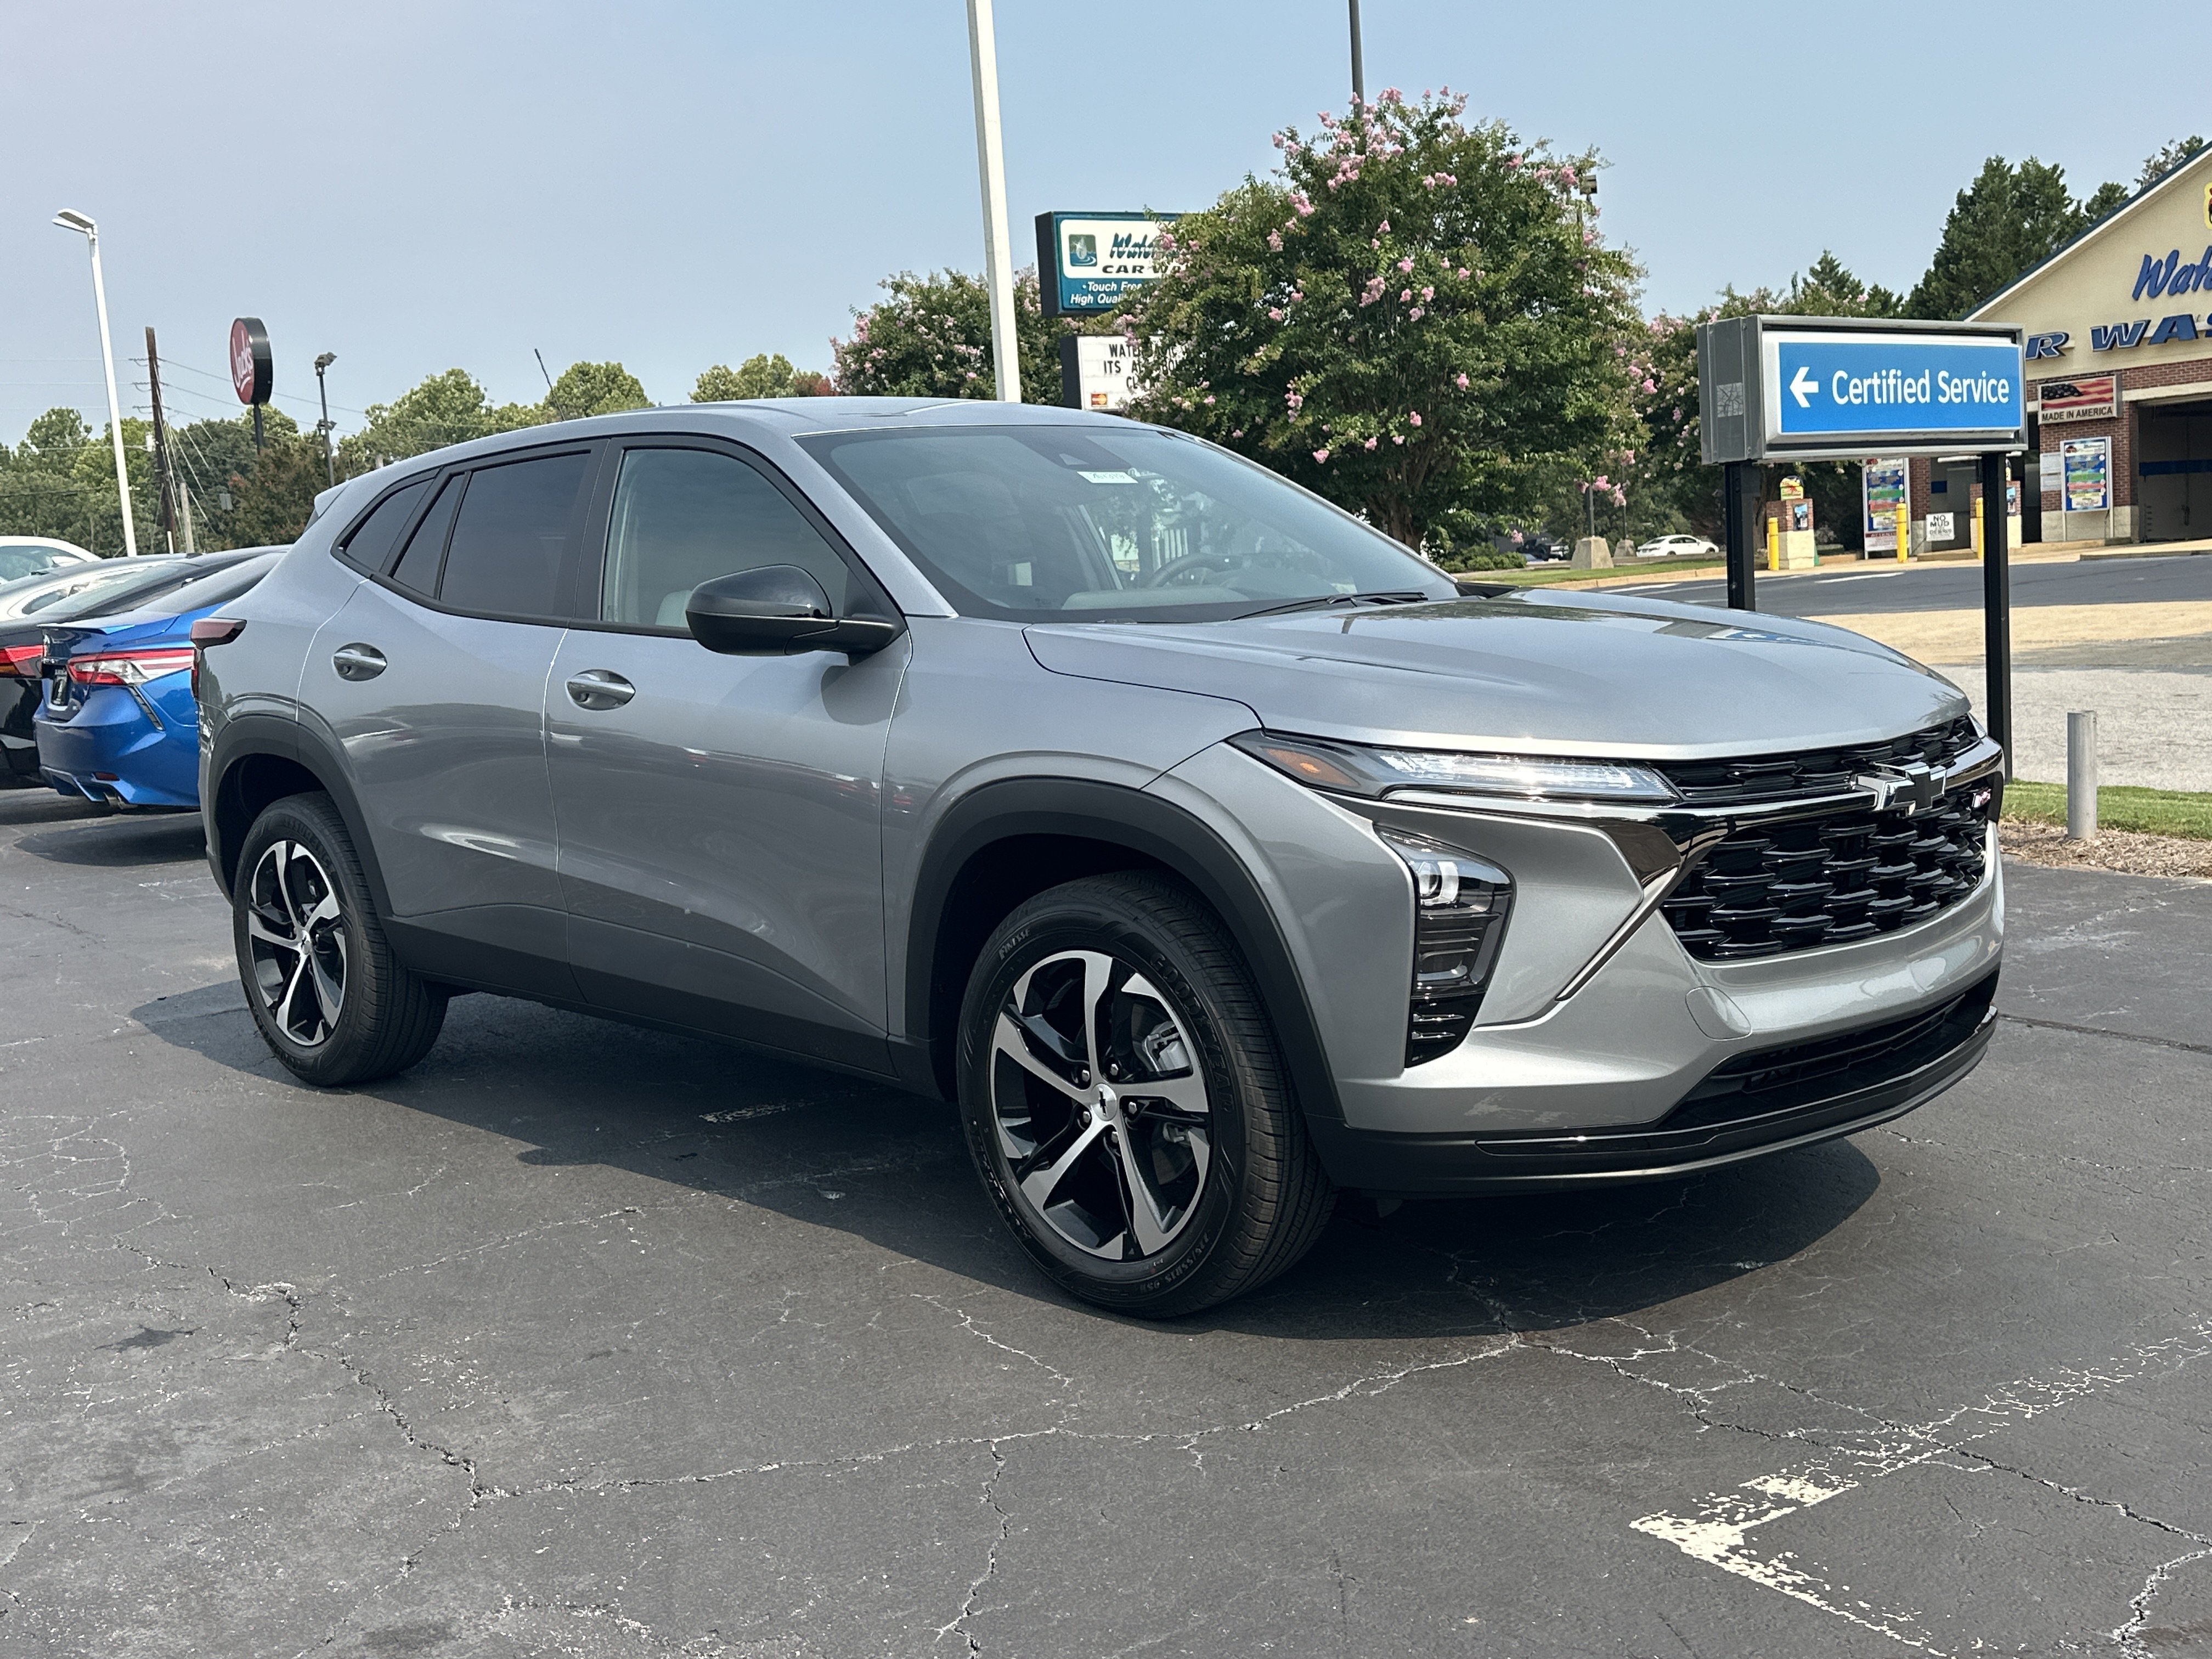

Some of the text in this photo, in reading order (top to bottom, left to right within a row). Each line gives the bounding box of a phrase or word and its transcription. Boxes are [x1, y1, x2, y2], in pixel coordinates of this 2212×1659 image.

[1102, 264, 1145, 274] CAR
[1087, 281, 1117, 291] Touch
[1070, 294, 1093, 306] High
[1104, 360, 1121, 374] ITS
[1832, 369, 2009, 405] Certified Service
[2042, 406, 2113, 421] MADE IN AMERICA
